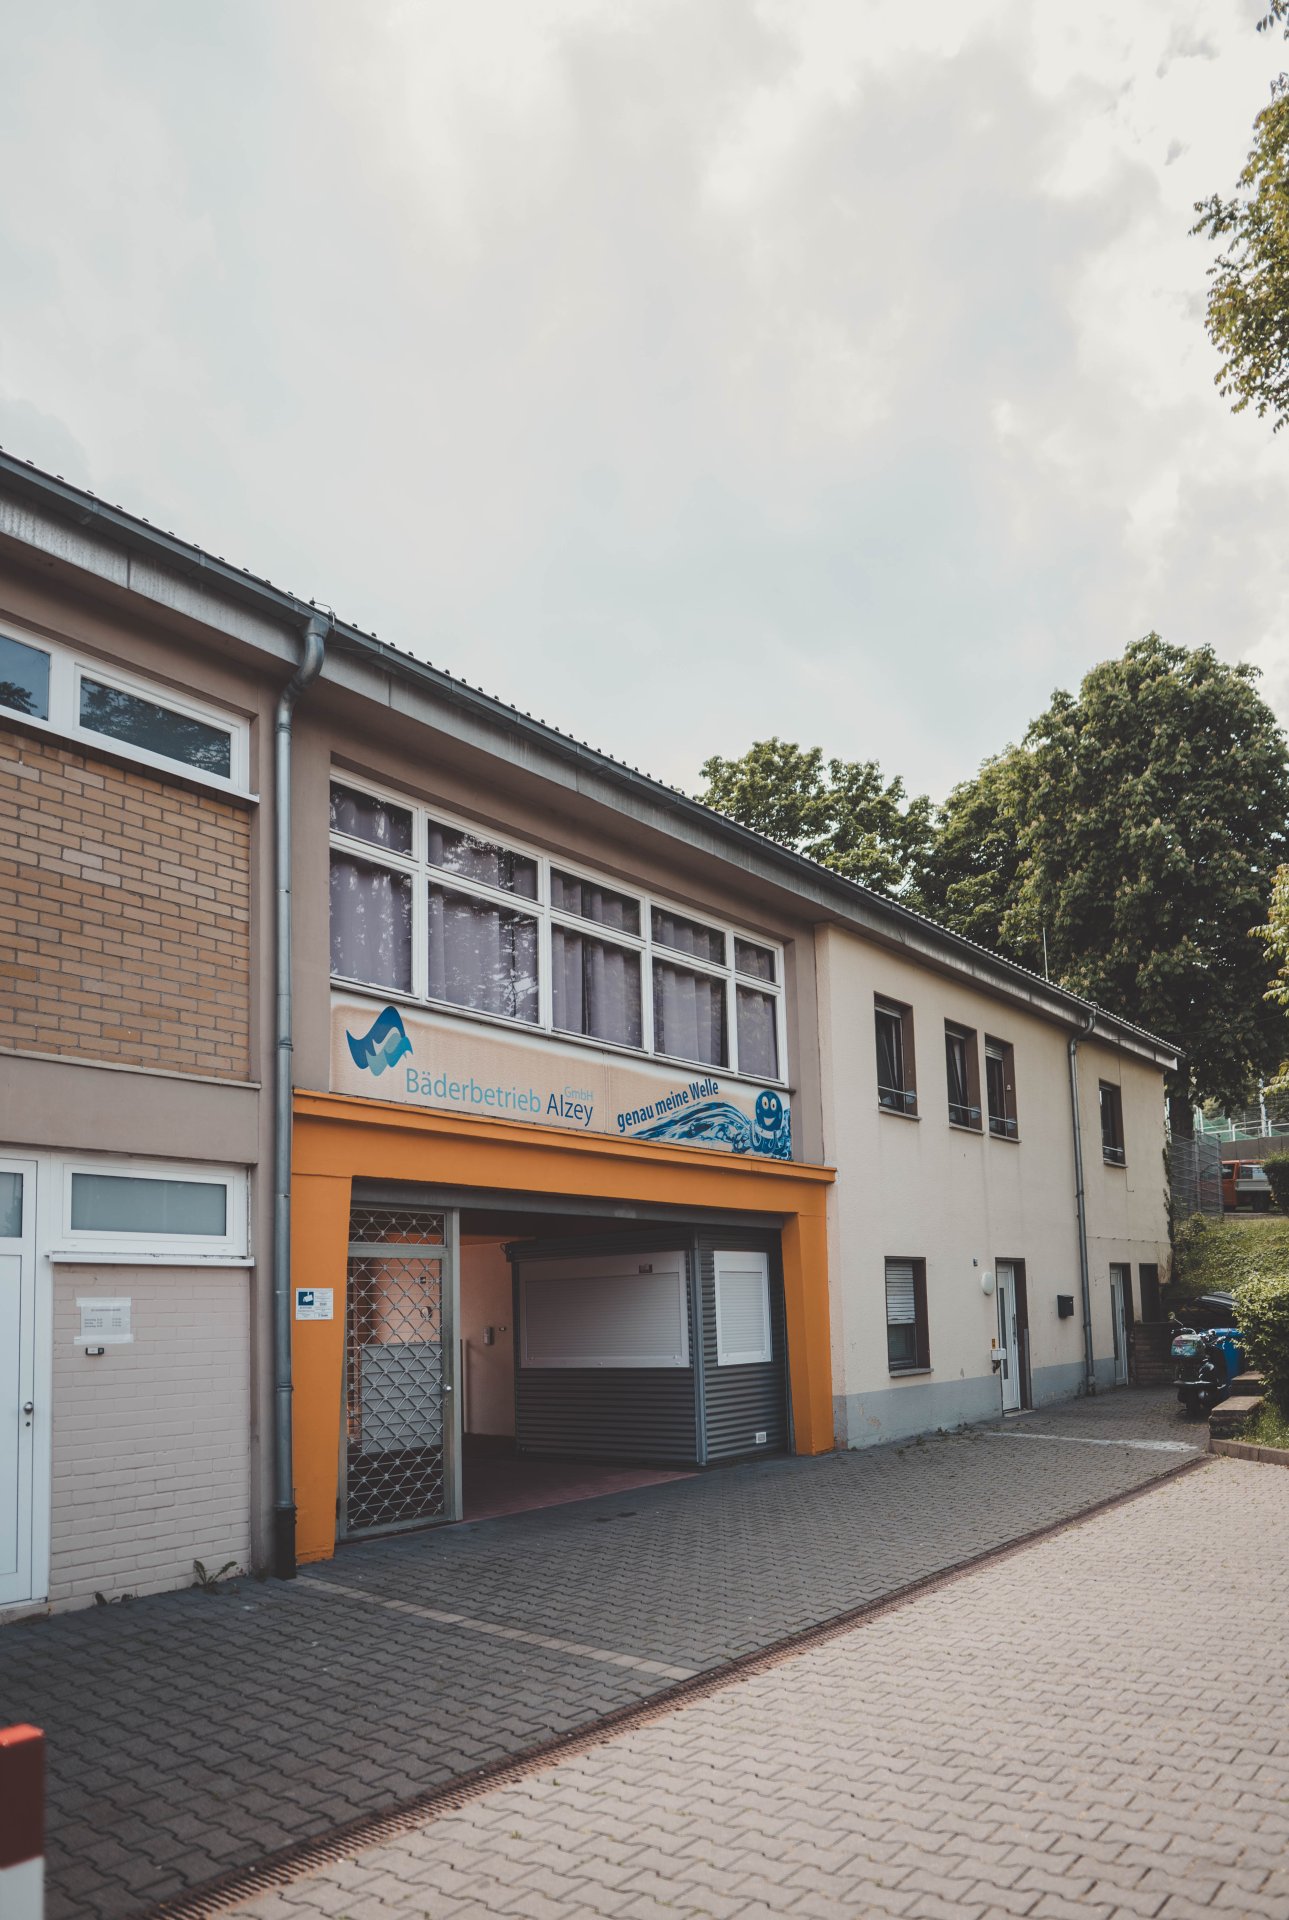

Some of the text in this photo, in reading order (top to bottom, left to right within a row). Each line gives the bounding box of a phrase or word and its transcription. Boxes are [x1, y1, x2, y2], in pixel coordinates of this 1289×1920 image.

[406, 1068, 593, 1127] Bäderbetrieb Alzey
[564, 1086, 593, 1102] GmbH
[617, 1078, 719, 1133] genau meine Welle
